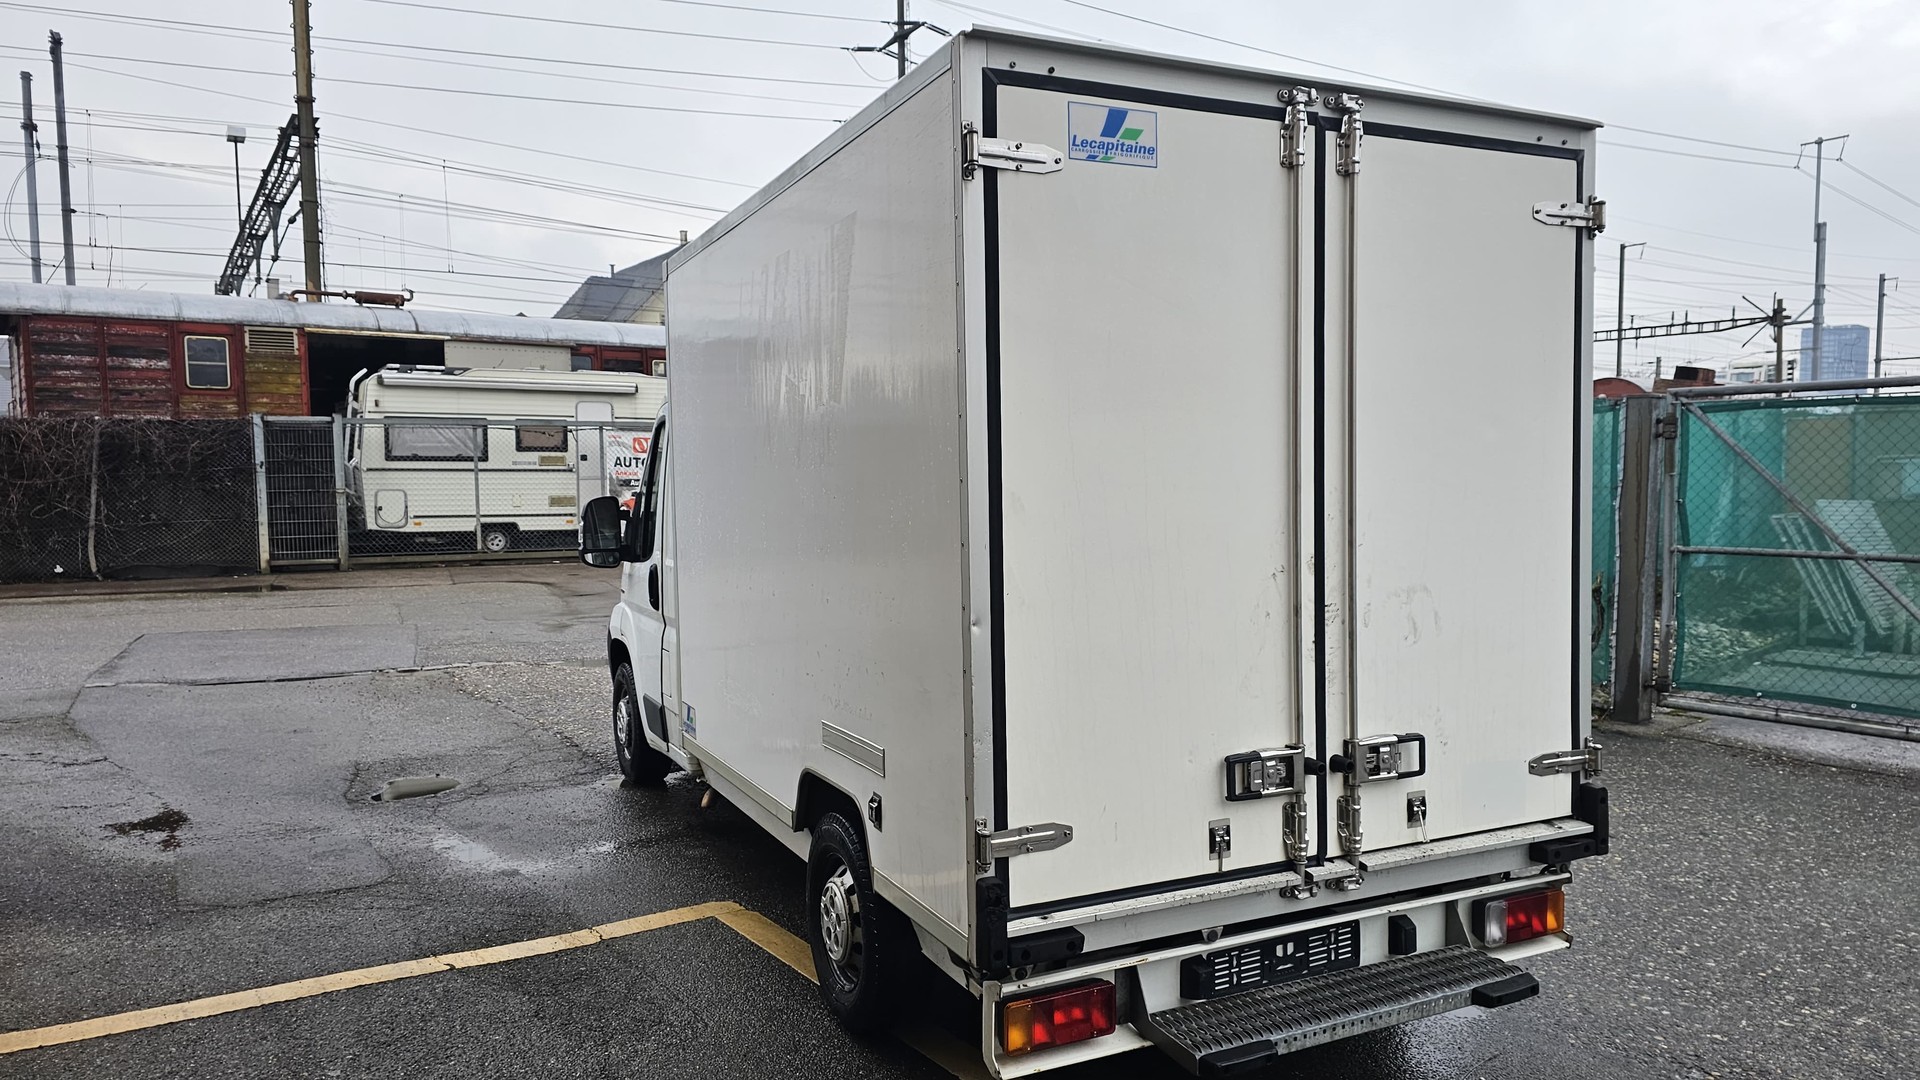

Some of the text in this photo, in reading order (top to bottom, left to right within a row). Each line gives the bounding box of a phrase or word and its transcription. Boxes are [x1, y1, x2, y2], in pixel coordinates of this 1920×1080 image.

[1071, 147, 1154, 160] CARROSSIER FRIGORIFIQUE
[1072, 134, 1155, 156] Lecapitaine
